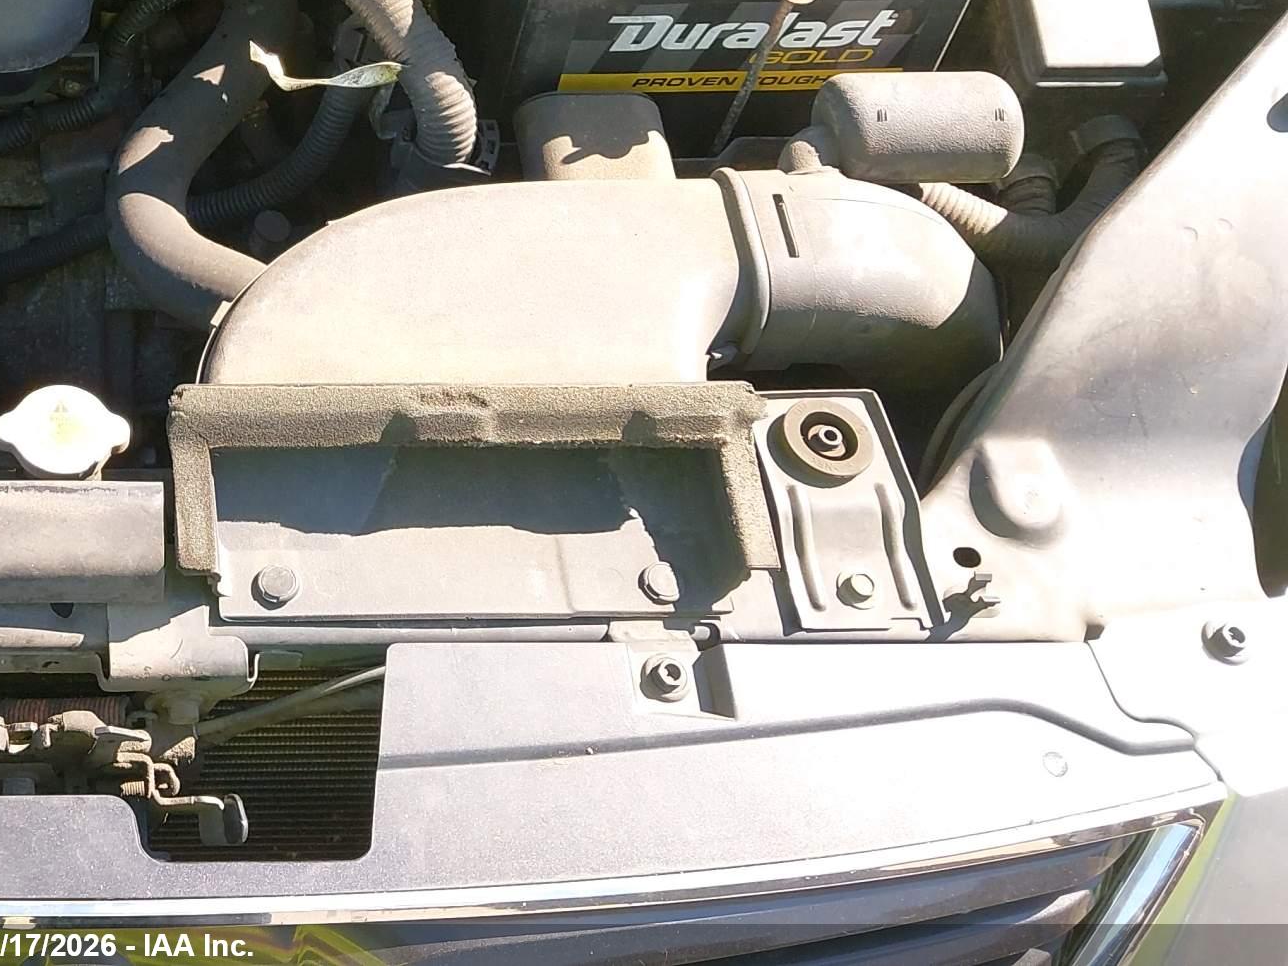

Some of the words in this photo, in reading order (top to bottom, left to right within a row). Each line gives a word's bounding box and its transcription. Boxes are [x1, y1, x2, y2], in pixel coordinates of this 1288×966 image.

[608, 9, 896, 52] Duralast
[749, 48, 874, 65] GOLD
[632, 76, 738, 88] PROVEN
[758, 75, 831, 86] OUGH
